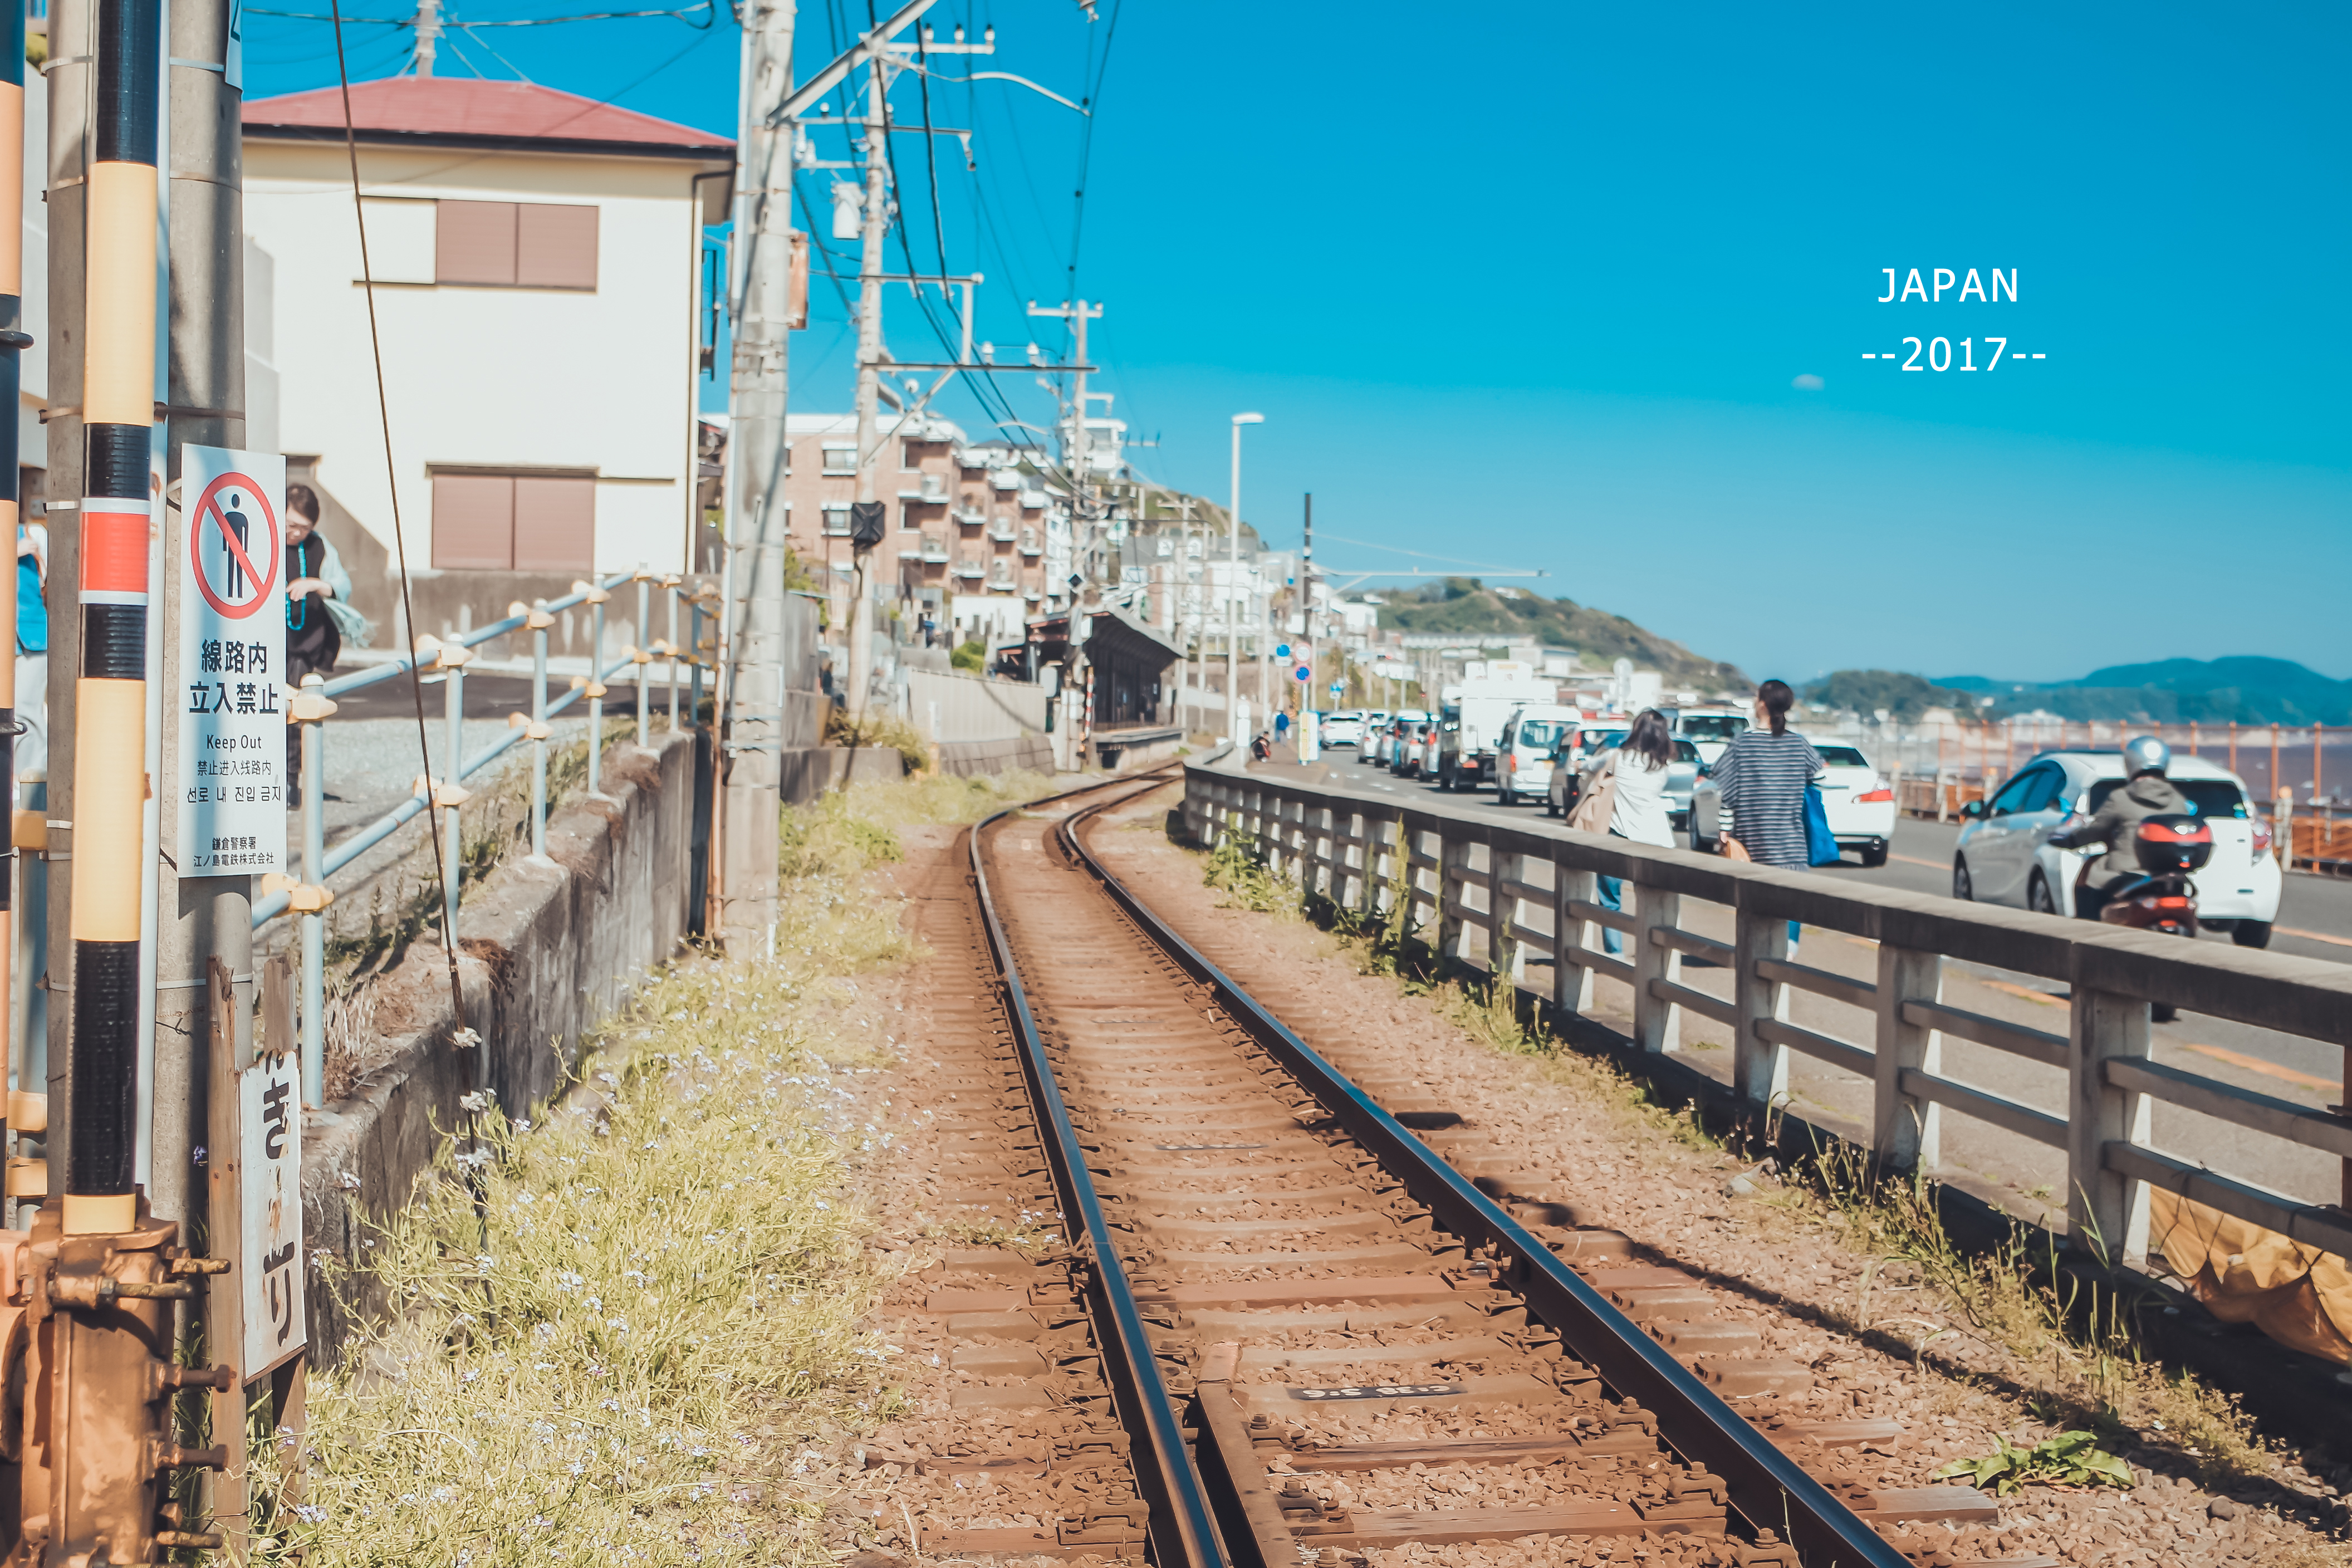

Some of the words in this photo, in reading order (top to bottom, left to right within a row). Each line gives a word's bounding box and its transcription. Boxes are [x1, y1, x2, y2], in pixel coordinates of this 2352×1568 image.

[201, 638, 267, 674] 線路内
[189, 680, 279, 715] 立入禁止
[207, 734, 237, 753] Keep
[241, 734, 262, 749] Out
[197, 759, 271, 777] 禁止进入线路内
[187, 786, 209, 803] 선로
[217, 786, 227, 803] 내
[235, 786, 256, 802] 진입
[261, 786, 281, 802] 금지
[212, 836, 256, 851] 鎌倉警察署
[193, 852, 275, 868] 江ノ島電鉄株式会社
